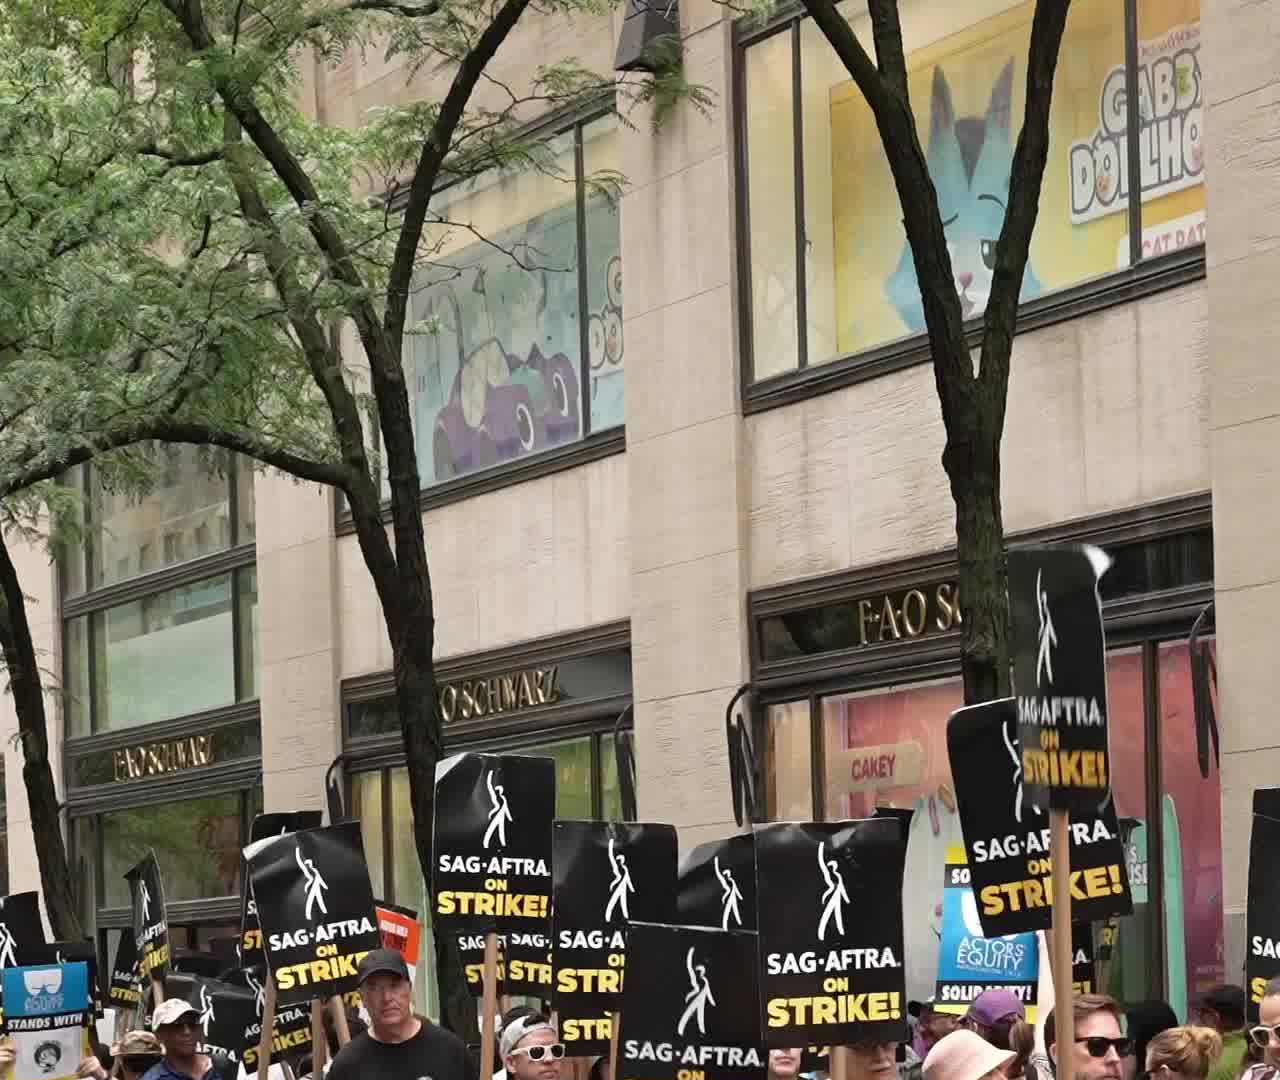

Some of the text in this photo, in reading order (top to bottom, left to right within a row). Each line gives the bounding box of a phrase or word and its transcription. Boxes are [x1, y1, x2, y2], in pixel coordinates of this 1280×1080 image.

[1040, 730, 1060, 750] ON
[1023, 750, 1107, 786] STRIKE!
[1027, 857, 1054, 875] ON
[485, 878, 508, 892] ON
[979, 864, 1124, 916] STRIKE!
[437, 890, 549, 918] STRIKE!
[315, 943, 339, 958] ON
[958, 936, 1025, 957] ACTORS
[275, 950, 370, 989] STRIK
[957, 949, 1024, 971] EQUITY
[823, 977, 850, 993] ON
[767, 991, 902, 1028] STRIKE!
[7, 1012, 83, 1030] STANDS WITH
